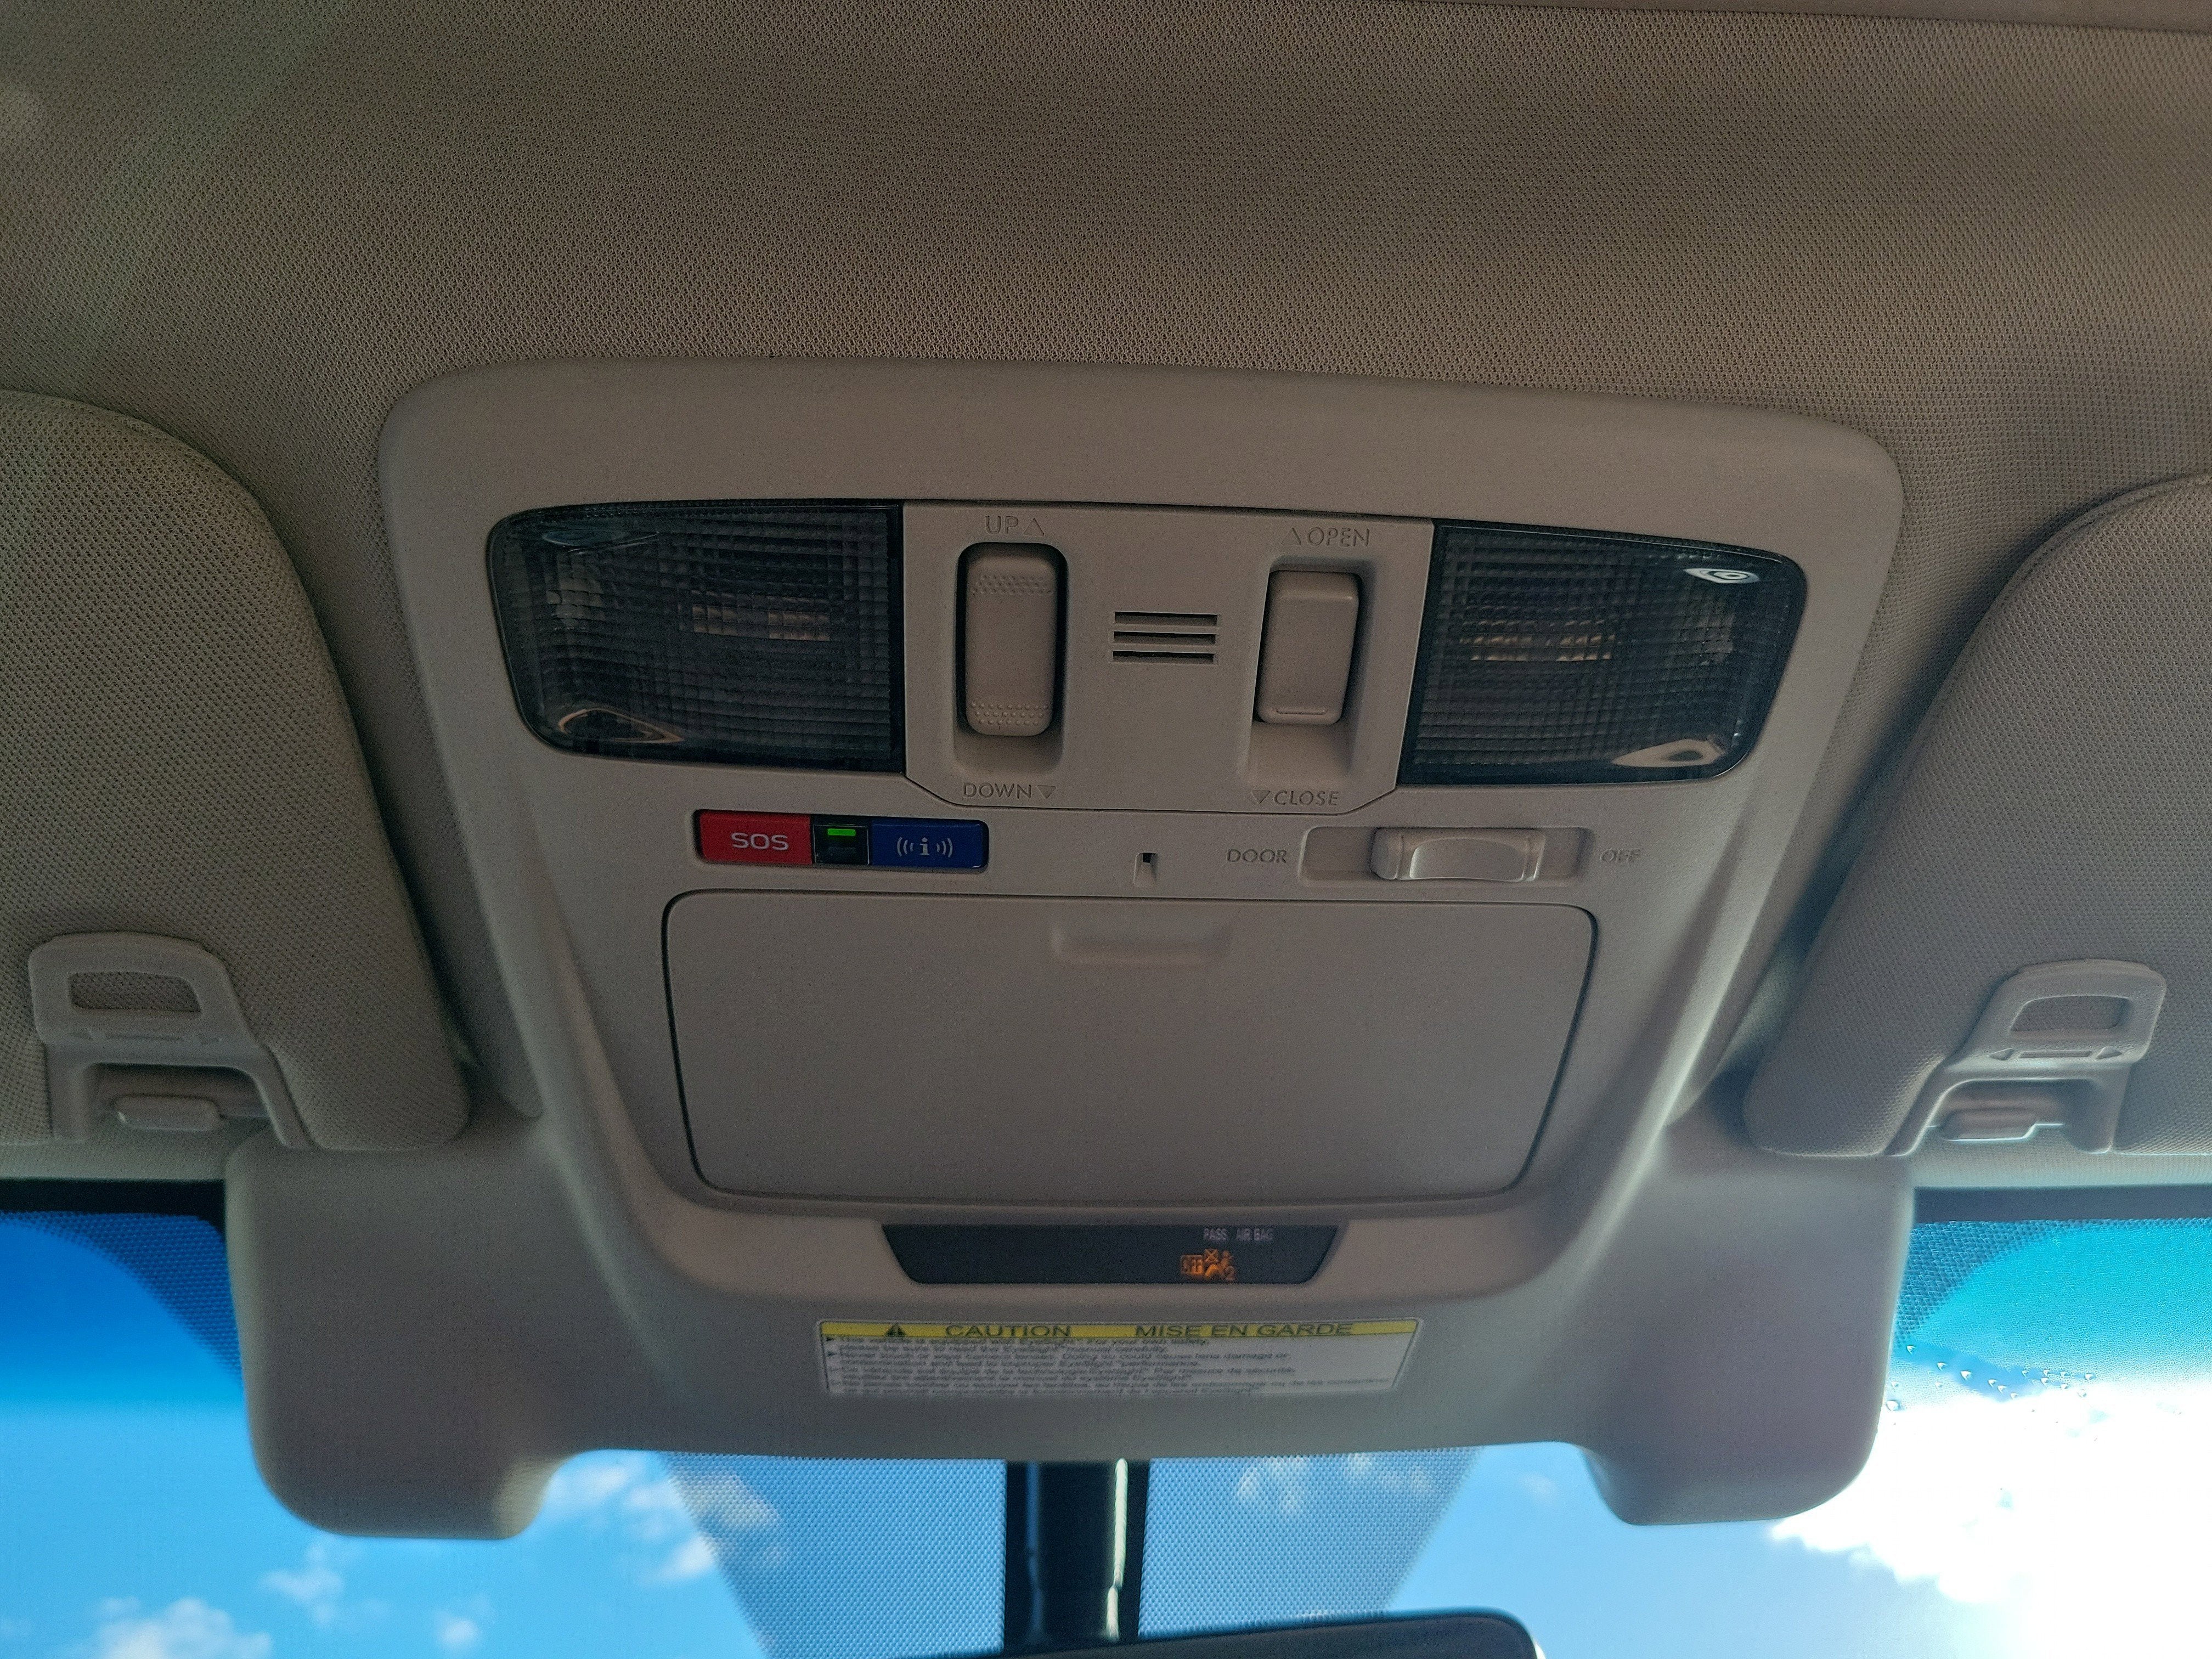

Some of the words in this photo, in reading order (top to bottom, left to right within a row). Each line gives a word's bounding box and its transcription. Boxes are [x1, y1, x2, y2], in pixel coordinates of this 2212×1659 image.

[985, 515, 1019, 535] UP
[1306, 527, 1370, 548] OPEN
[962, 782, 1033, 800] DOWN
[1273, 789, 1340, 806] CLOSE
[731, 832, 789, 851] SOS
[1226, 848, 1287, 864] DOOR
[1600, 848, 1641, 863] OFF
[1203, 1228, 1228, 1241] PASS
[1254, 1228, 1273, 1241] BAG
[946, 1324, 1071, 1338] CAUTION
[1135, 1324, 1202, 1338] MISE
[1211, 1324, 1248, 1337] EN
[1256, 1323, 1354, 1336] GARDE
